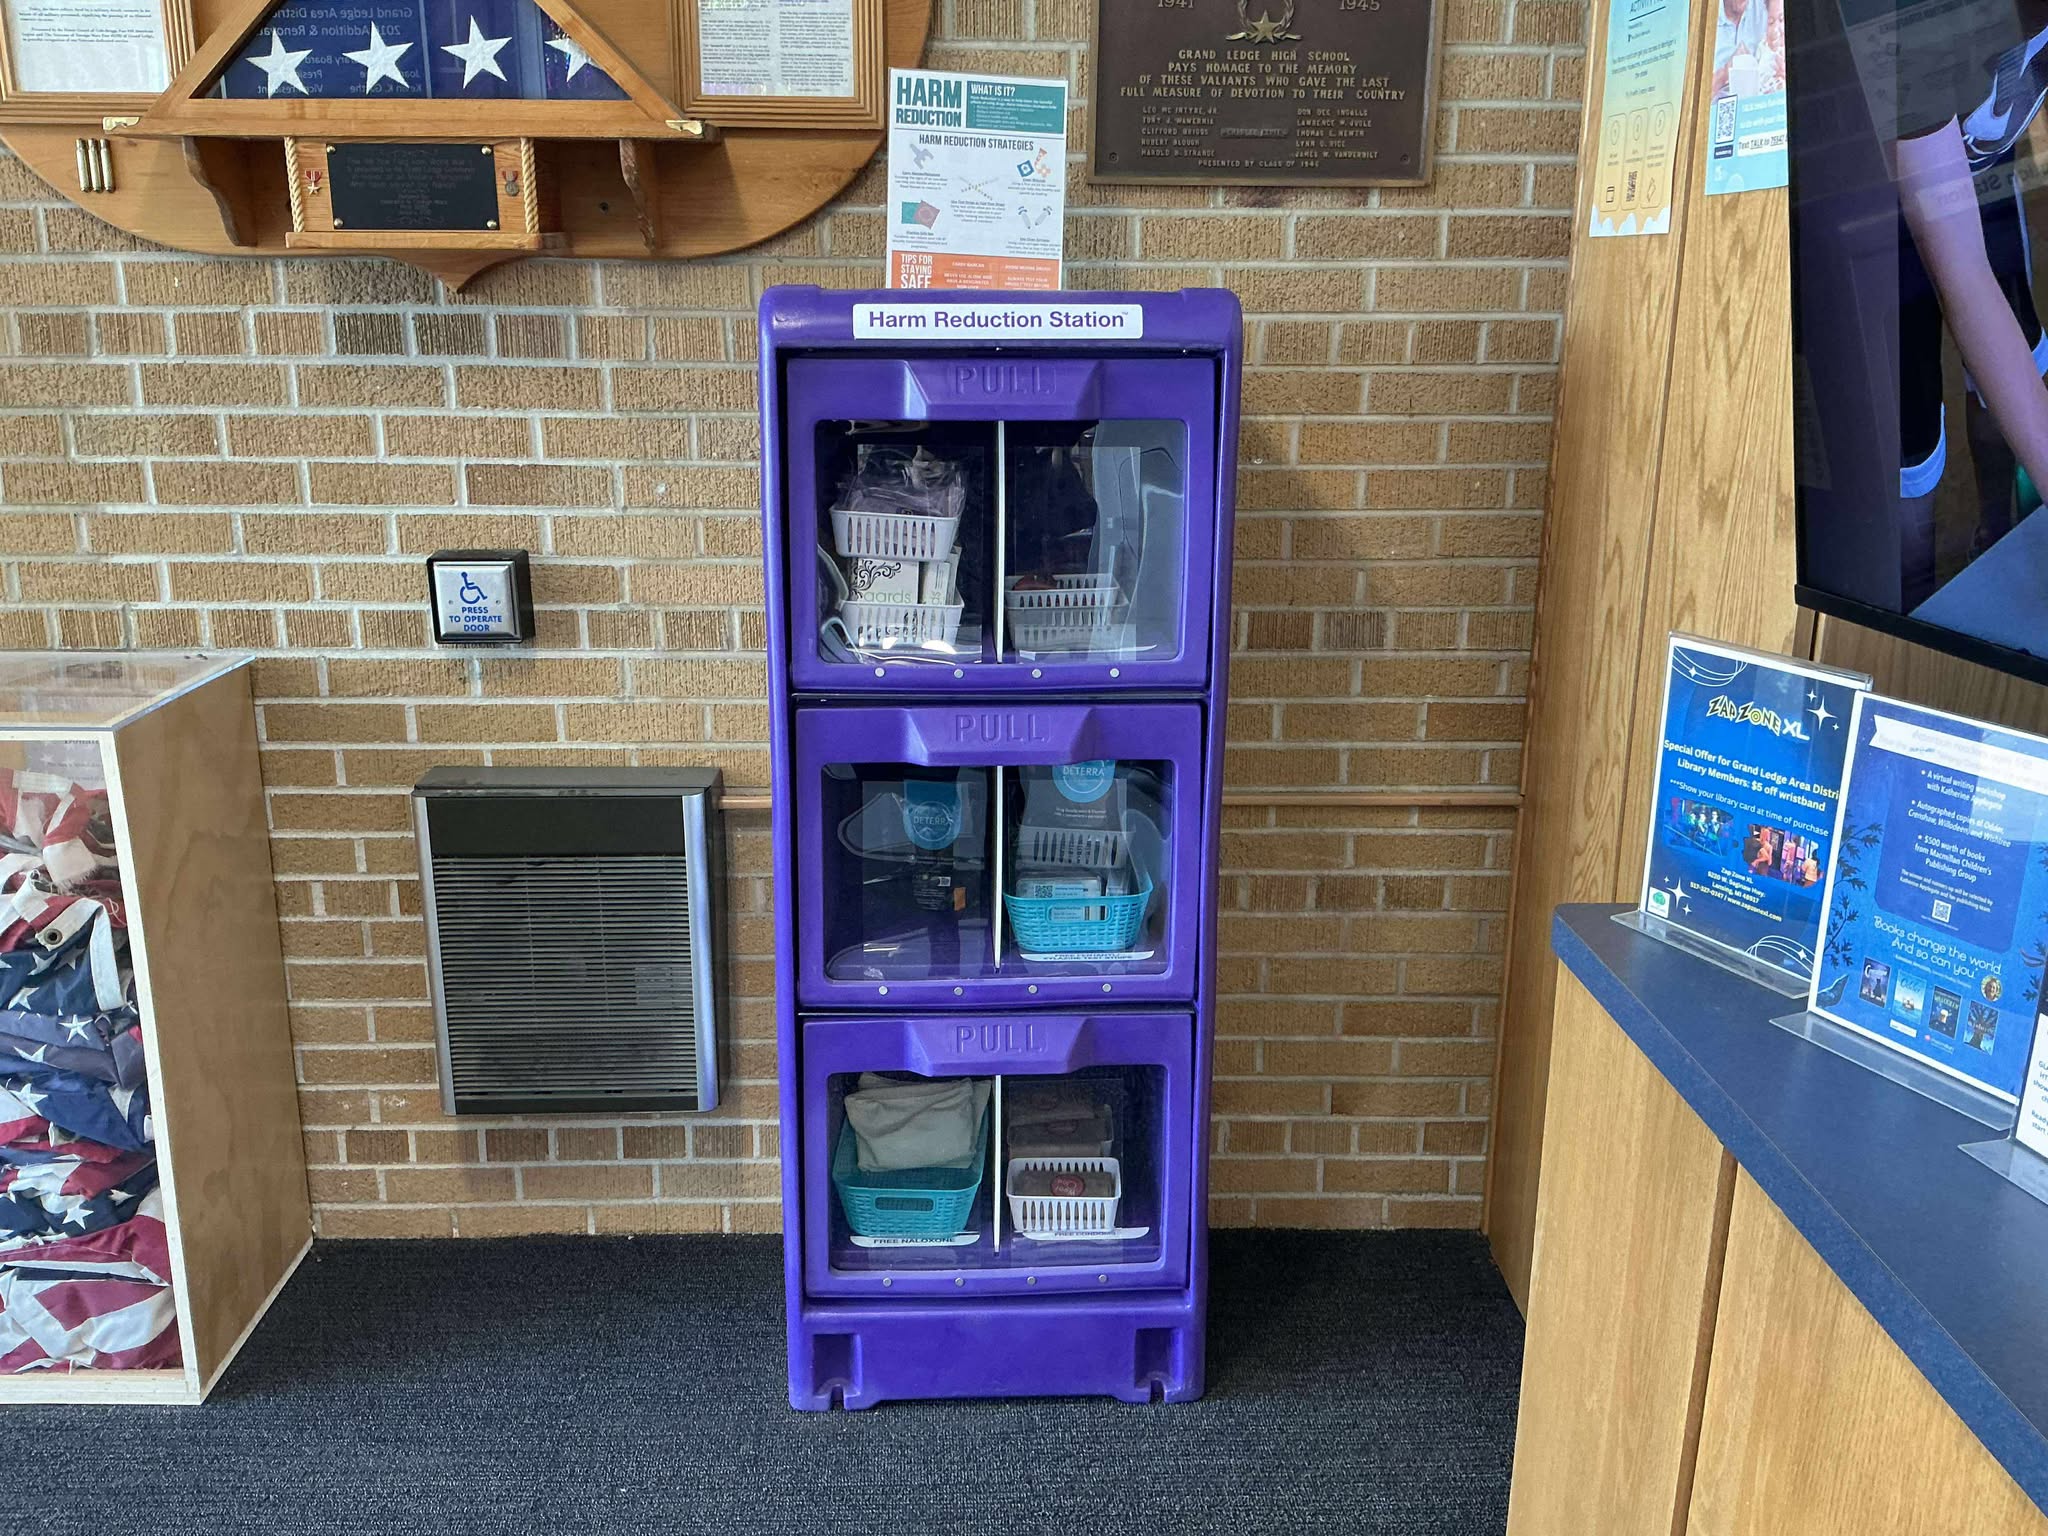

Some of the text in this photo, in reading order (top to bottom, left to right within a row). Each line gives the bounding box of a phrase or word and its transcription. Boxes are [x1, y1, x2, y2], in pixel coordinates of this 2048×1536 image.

[1178, 49, 1350, 61] GRAND LEDGE HIGH SCHOOL
[1168, 62, 1357, 75] PAYS HOMAGE TO THE MEMORY
[970, 84, 1016, 97] WHAT IS IT?
[1139, 74, 1389, 88] OF THESE VALIANTS WHO GAVE THE LAST
[896, 77, 962, 109] HARM
[1120, 87, 1406, 100] FULL MEASURE OF DEVOTION TO THEIR COUNTRY
[896, 108, 962, 127] REDUCTION
[919, 134, 1034, 151] HARM REDUCTION STRATEGIES
[1245, 160, 1254, 168] BY
[901, 254, 933, 265] TIPS FOR
[901, 264, 933, 275] STAYING
[869, 311, 927, 328] Harm
[934, 311, 1042, 328] Reduction
[955, 365, 1047, 394] PULL
[449, 615, 502, 623] TO OPERATE
[461, 606, 489, 614] PRESS
[464, 624, 490, 632] DOOR
[1706, 695, 1810, 741] ZAP ZONE XL
[955, 714, 1045, 742] PULL
[1063, 766, 1105, 777] DETERRA
[1664, 739, 1693, 757] Special
[1695, 749, 1717, 763] Offer
[1718, 755, 1731, 766] for
[1732, 760, 1759, 776] Grand
[1760, 768, 1788, 785] Ledge
[1788, 777, 1811, 792] Area
[1677, 758, 1826, 812] Library Members: $5 off wristband
[1927, 770, 1933, 779] A
[1933, 773, 1953, 784] virtual
[1952, 778, 1975, 793] writing
[1926, 782, 1941, 792] with
[1941, 786, 1970, 801] Katherine
[1698, 789, 1715, 799] your
[1715, 793, 1739, 809] library
[1739, 802, 1756, 813] card
[1756, 808, 1764, 816] at
[1765, 810, 1783, 822] time
[1783, 816, 1793, 825] of
[1793, 820, 1829, 837] purchase
[1917, 800, 1956, 819] Autographed
[1914, 842, 1930, 855] from
[1941, 842, 1959, 854] worth
[1960, 847, 1967, 855] of
[1966, 848, 1986, 863] books
[1925, 857, 1977, 883] Publishing Group
[1891, 936, 1951, 969] And so can
[1907, 931, 1947, 954] change
[1948, 946, 1967, 962] the
[956, 1024, 1043, 1053] PULL
